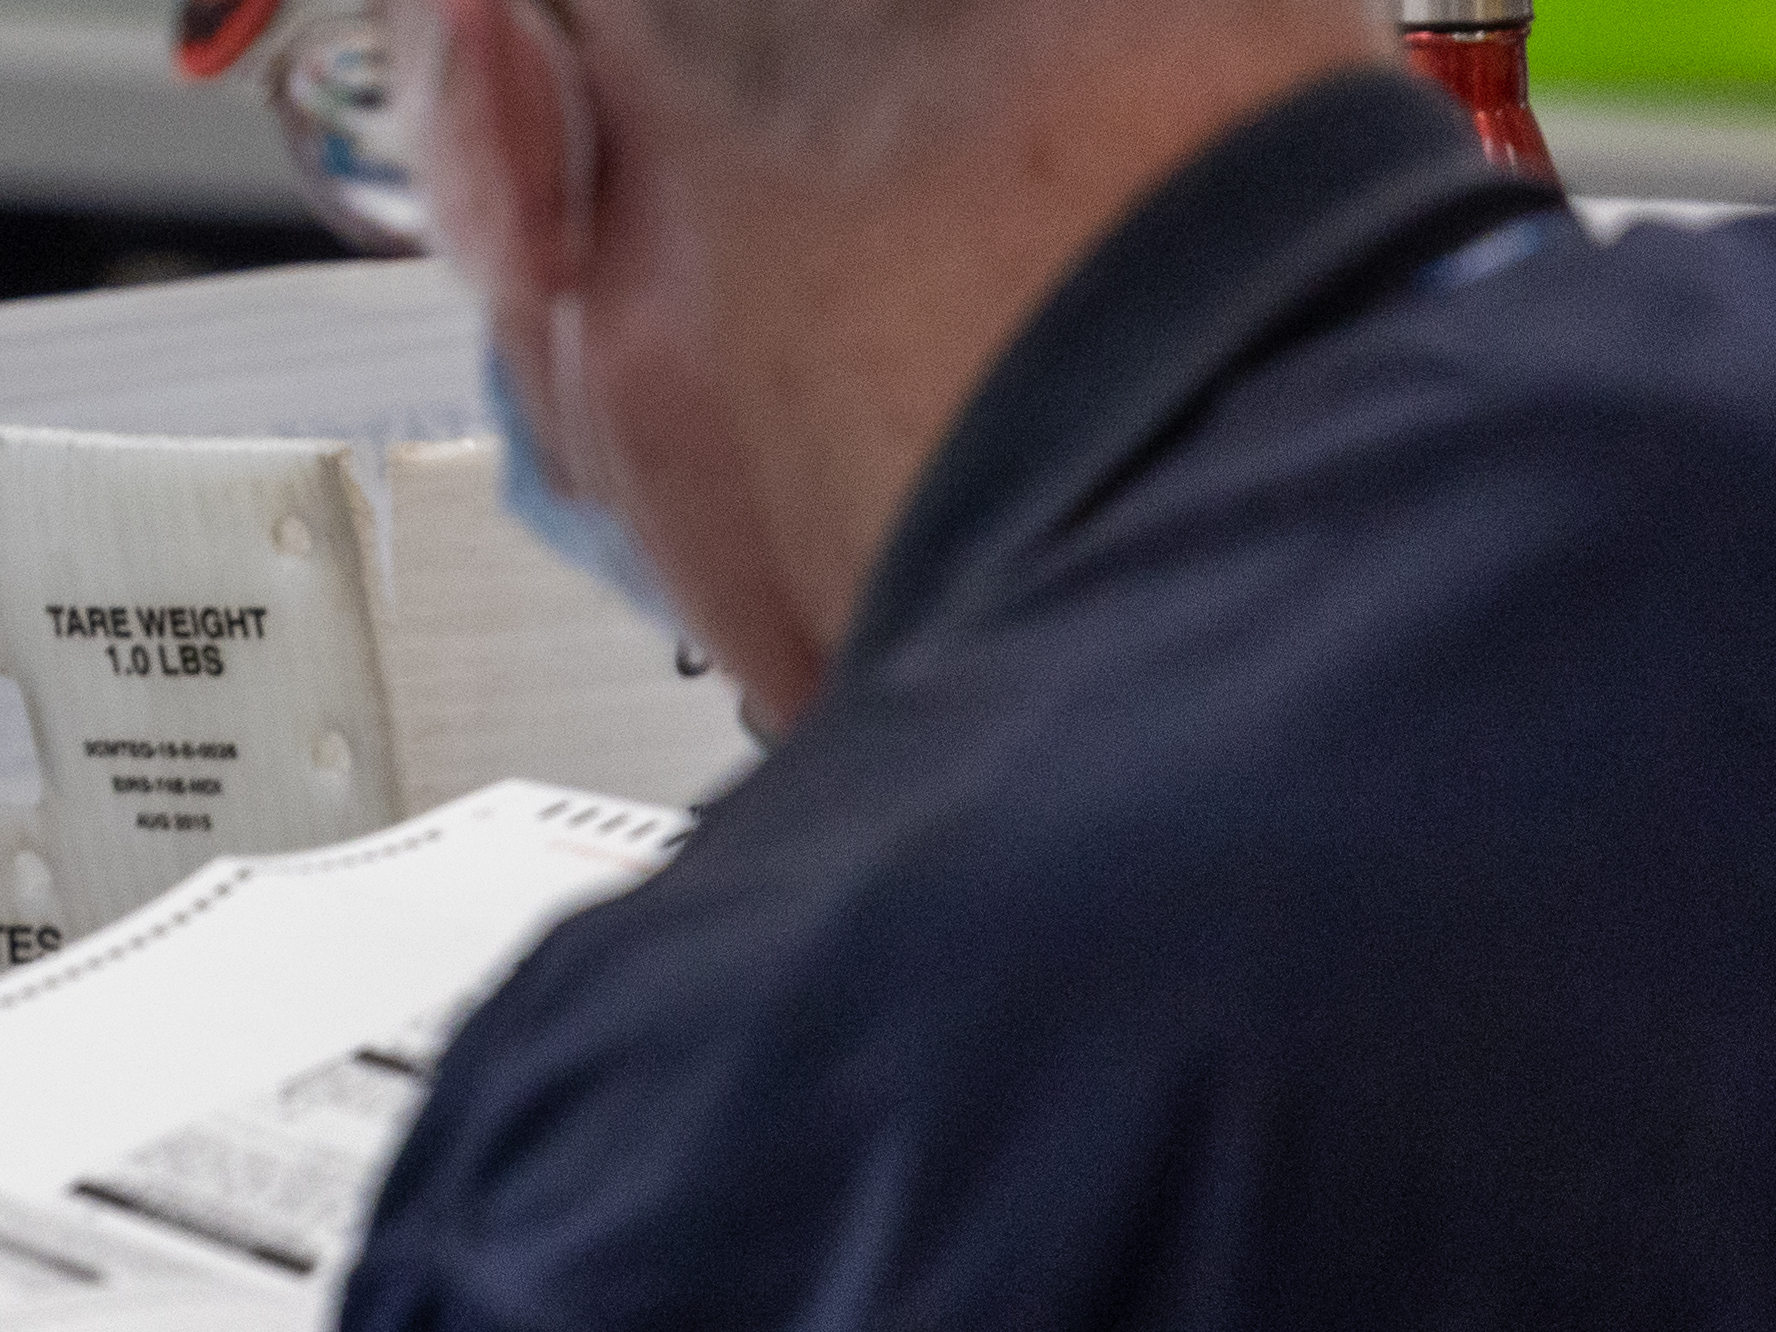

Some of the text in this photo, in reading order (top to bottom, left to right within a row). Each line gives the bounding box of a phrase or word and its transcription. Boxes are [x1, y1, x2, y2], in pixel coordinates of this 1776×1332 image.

[46, 605, 267, 639] TARE WEIGHT
[105, 644, 226, 677] 1.0 LBS
